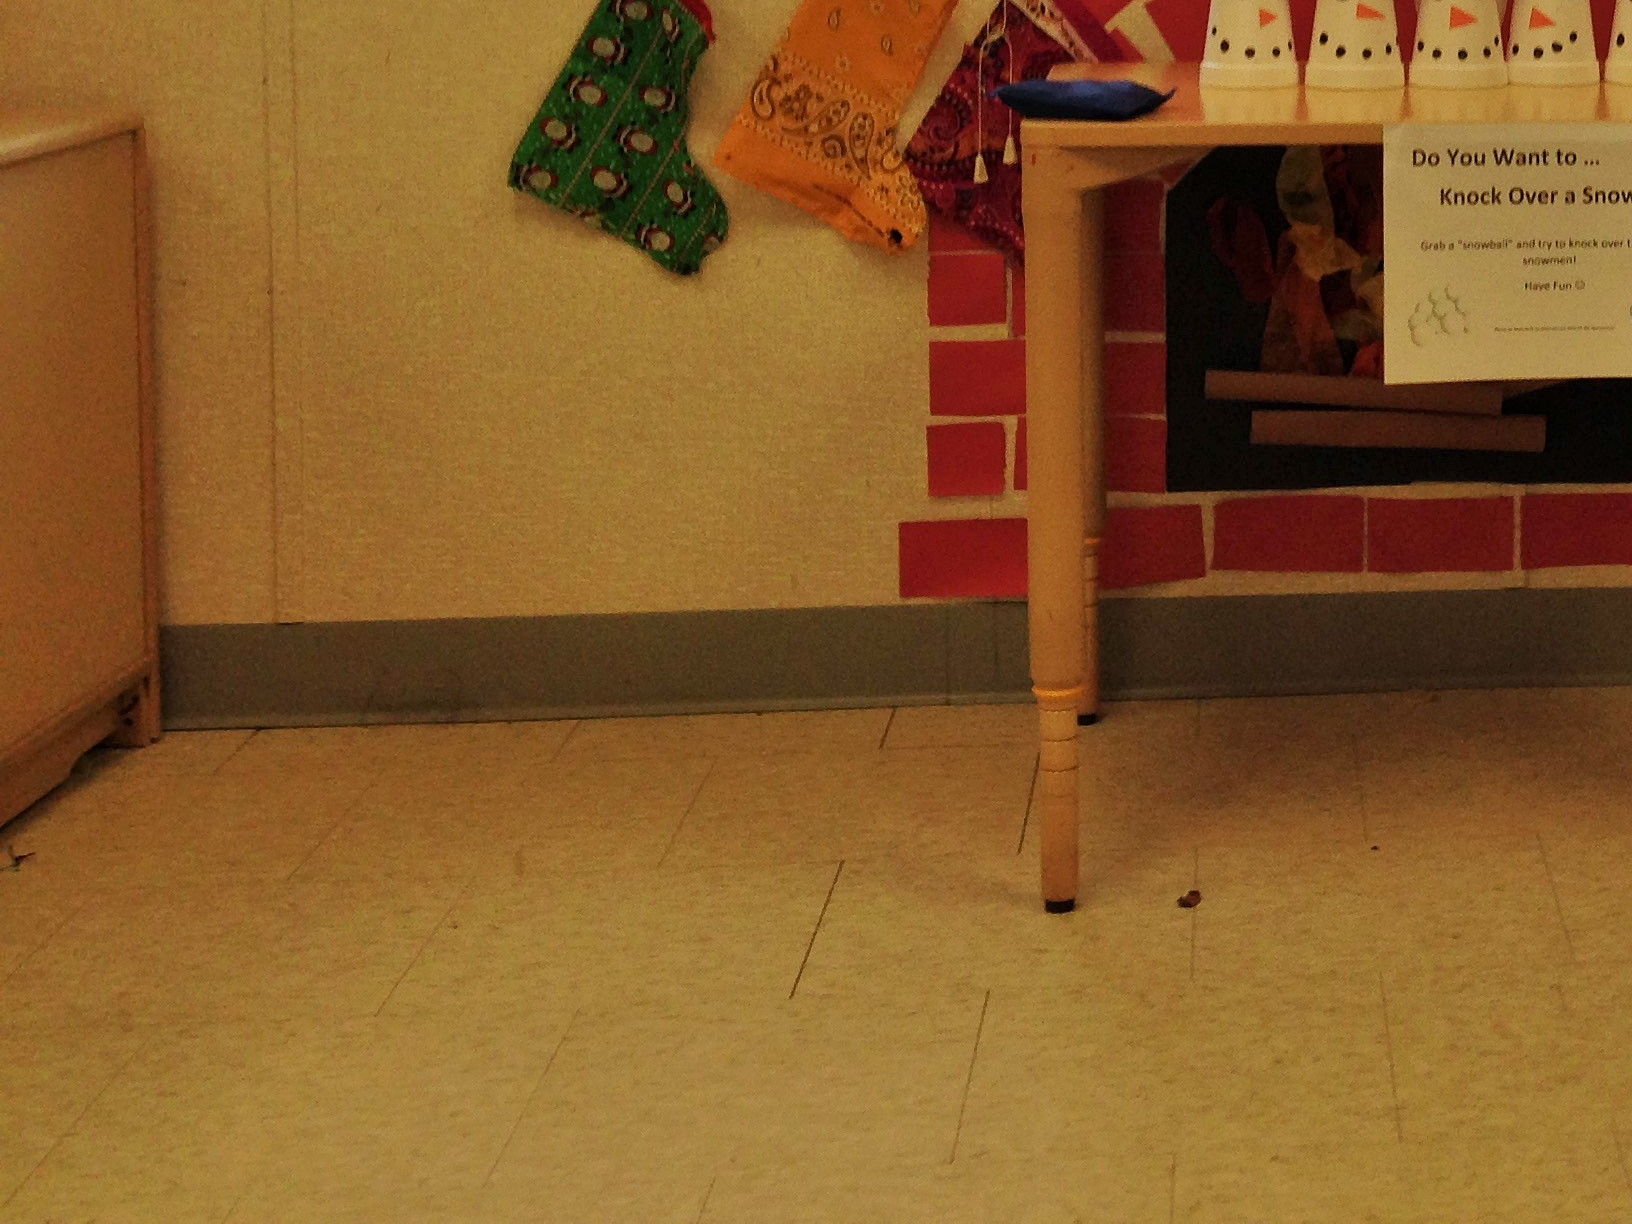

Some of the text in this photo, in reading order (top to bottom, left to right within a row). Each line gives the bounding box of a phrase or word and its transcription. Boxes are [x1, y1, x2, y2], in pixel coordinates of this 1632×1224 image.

[1411, 148, 1440, 167] Do
[1447, 147, 1486, 167] You
[1493, 147, 1549, 167] Want
[1556, 148, 1577, 166] to
[1440, 185, 1501, 206] Knock
[1508, 186, 1558, 206] Over
[1565, 189, 1576, 205] a
[1420, 239, 1446, 251] Grab
[1448, 241, 1455, 251] a
[1516, 239, 1536, 250] and
[1538, 239, 1552, 251] try
[1555, 239, 1566, 249] to
[1569, 237, 1599, 249] knock
[1601, 239, 1623, 249] over
[1524, 280, 1572, 291] Have Fun
